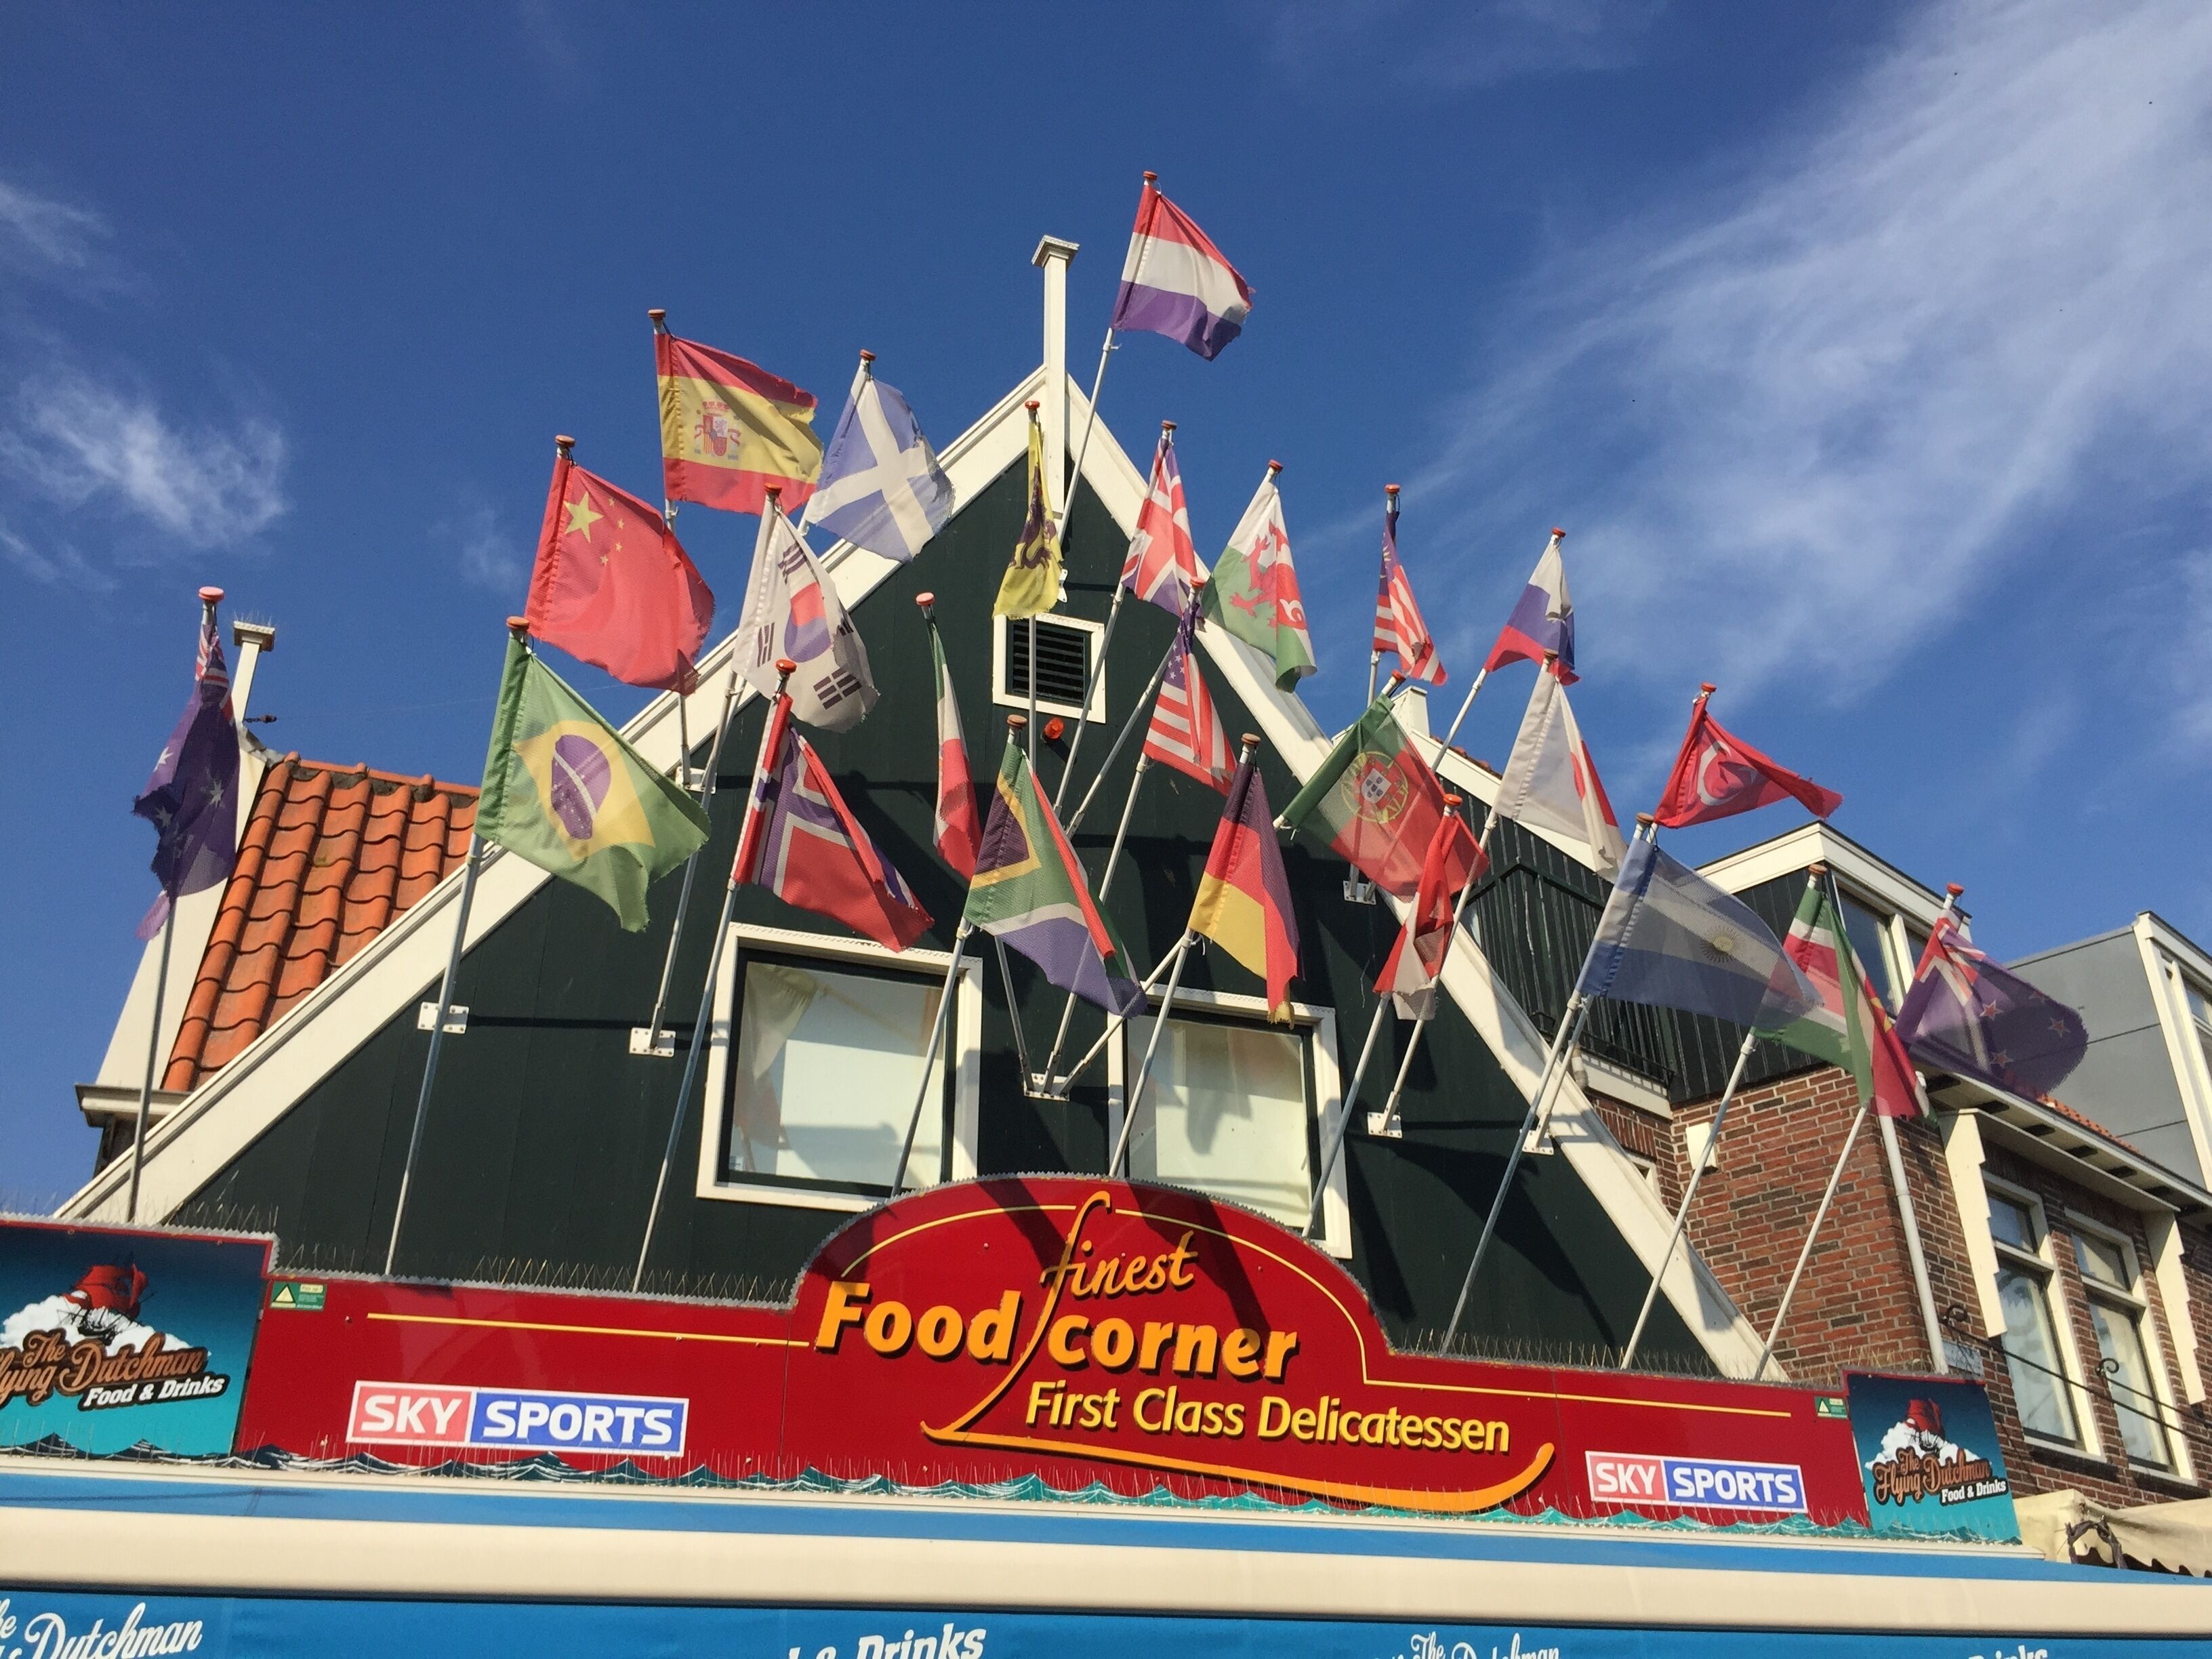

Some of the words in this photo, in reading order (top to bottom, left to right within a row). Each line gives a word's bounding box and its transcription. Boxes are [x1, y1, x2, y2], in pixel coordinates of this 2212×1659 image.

[23, 1331, 66, 1368] The
[815, 1281, 1021, 1361] Food
[1048, 1313, 1299, 1379] corner
[0, 1352, 58, 1405] lying
[60, 1332, 203, 1393] Dutchman
[83, 1383, 138, 1408] Food
[139, 1384, 155, 1401] &
[158, 1376, 225, 1399] Drinks
[361, 1394, 462, 1435] SKY
[483, 1400, 674, 1446] SPORTS
[1027, 1379, 1120, 1428] First
[1133, 1385, 1245, 1437] Class
[1257, 1395, 1510, 1452] Delicatessen
[1595, 1462, 1657, 1496] SKY
[1673, 1467, 1797, 1504] SPORTS
[1875, 1463, 1921, 1504] Flying
[1922, 1448, 1990, 1493] Dutchman
[1898, 1448, 1921, 1476] The
[1941, 1486, 1965, 1503] Food
[1967, 1486, 1974, 1498] &
[1976, 1479, 2007, 1497] Drinks
[24, 1602, 203, 1659] Dutchman
